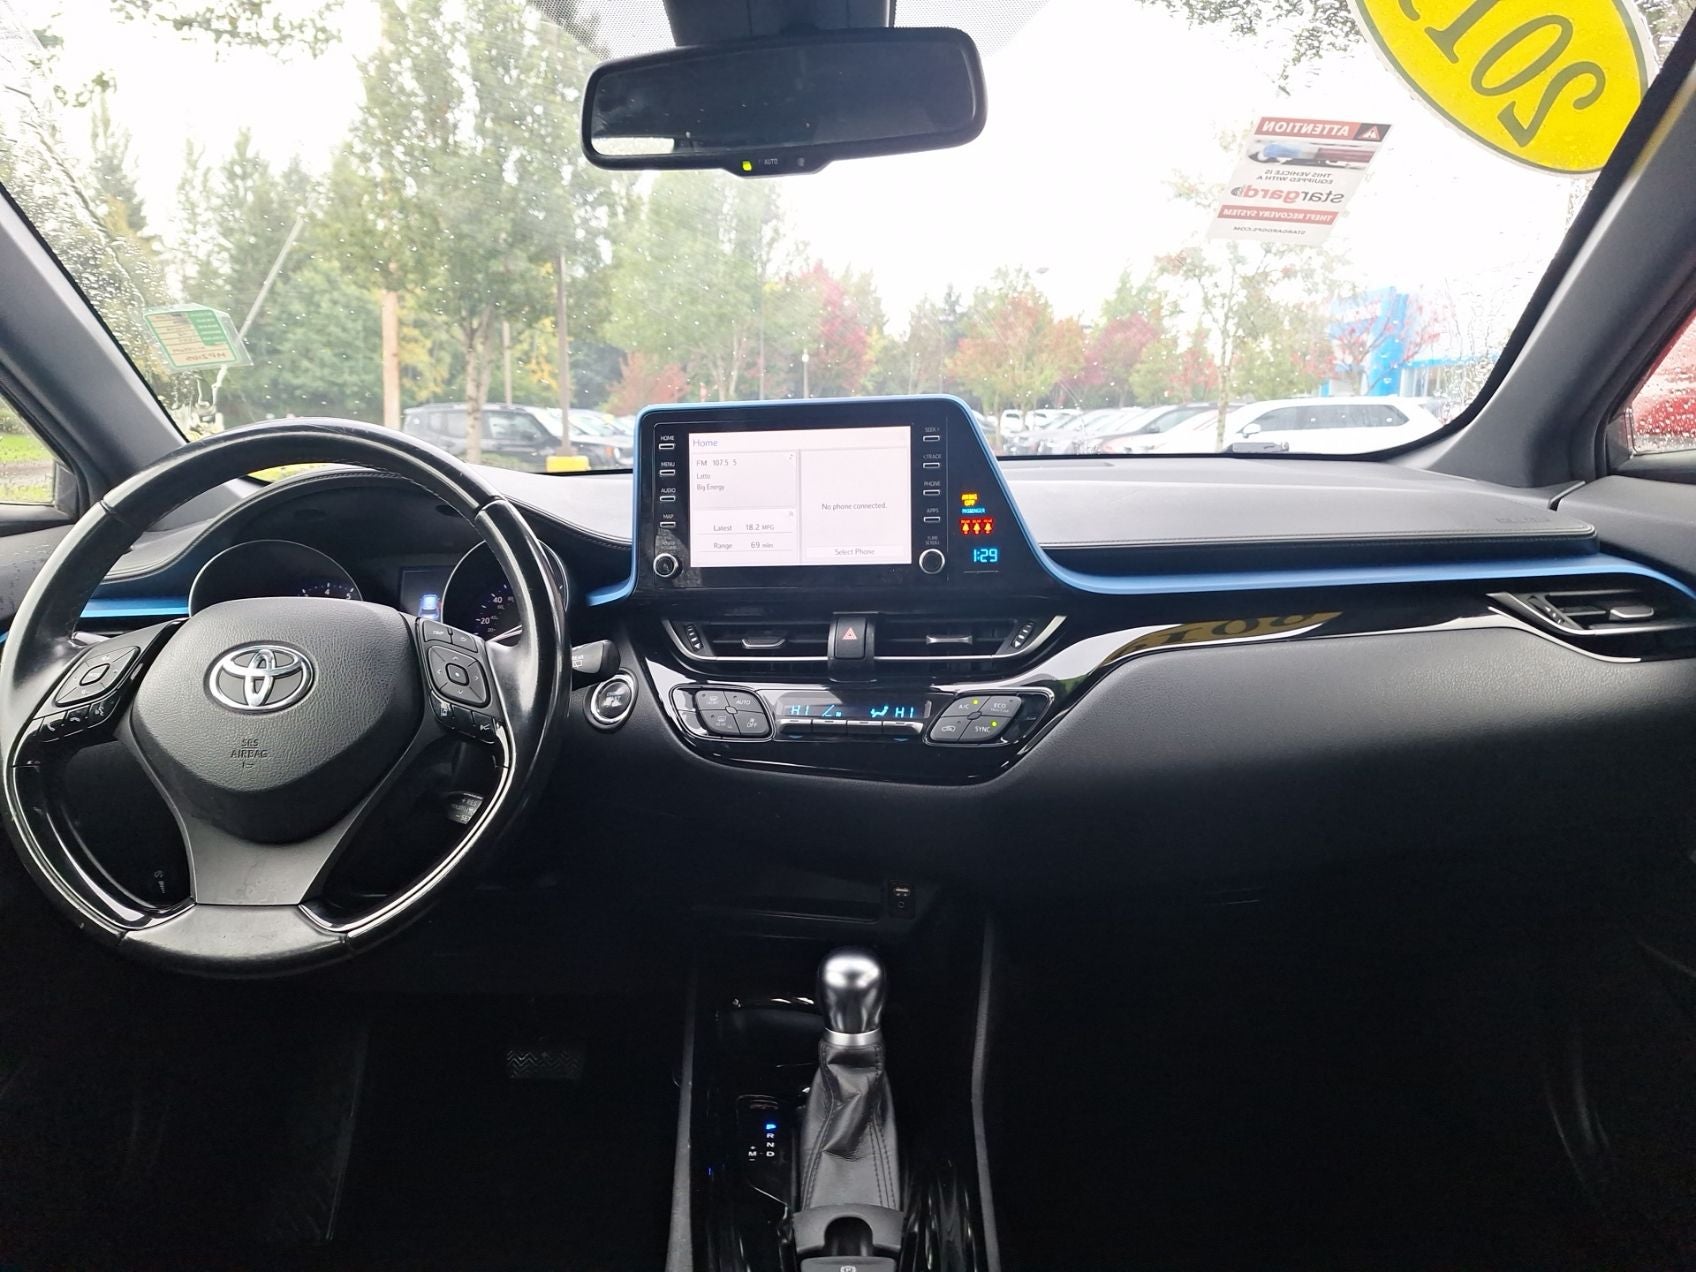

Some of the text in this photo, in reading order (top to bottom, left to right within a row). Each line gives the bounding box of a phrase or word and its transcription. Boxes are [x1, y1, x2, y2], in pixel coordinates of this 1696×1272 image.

[692, 438, 718, 448] Home
[696, 459, 708, 467] FM
[696, 483, 725, 492] Big Energy
[832, 503, 852, 512] phone
[852, 502, 888, 510] connected.
[713, 524, 733, 532] Latest
[745, 523, 761, 531] 18.2
[713, 542, 733, 550] Range
[750, 541, 761, 549] 69
[834, 547, 876, 556] Select Phone
[973, 548, 998, 563] 1:29
[324, 588, 330, 596] 4
[493, 596, 503, 604] 40
[480, 617, 490, 625] 20
[790, 704, 810, 716] HI
[894, 706, 914, 719] HI
[241, 738, 259, 747] SRS
[230, 749, 269, 759] AIRBAG
